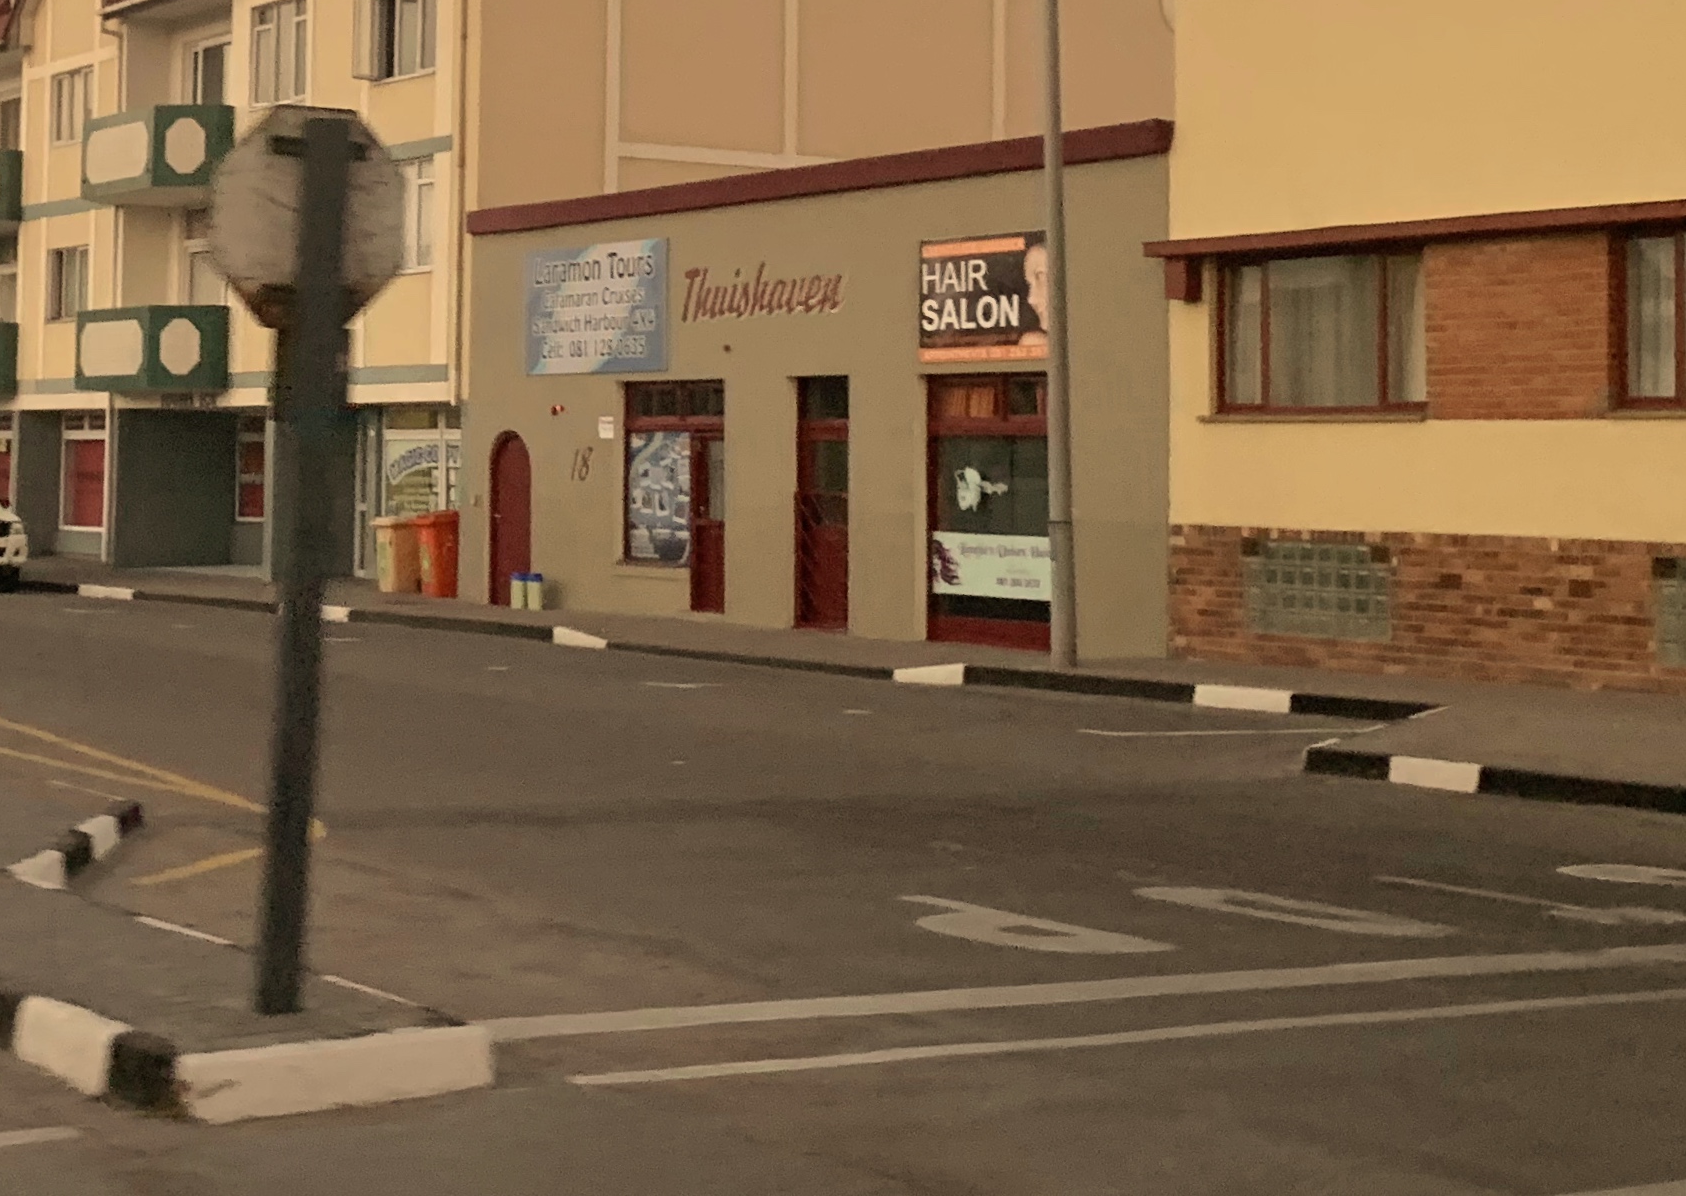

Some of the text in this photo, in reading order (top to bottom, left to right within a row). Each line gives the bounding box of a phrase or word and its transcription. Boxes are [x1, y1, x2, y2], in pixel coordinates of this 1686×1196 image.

[534, 252, 654, 286] Laramon Tours
[921, 258, 989, 295] HAIR
[601, 286, 645, 306] Cruises
[681, 261, 843, 322] Thuishaven
[532, 314, 581, 335] Sandwich
[584, 314, 629, 332] Harbour
[921, 293, 1020, 332] SALON
[570, 446, 594, 481] 18
